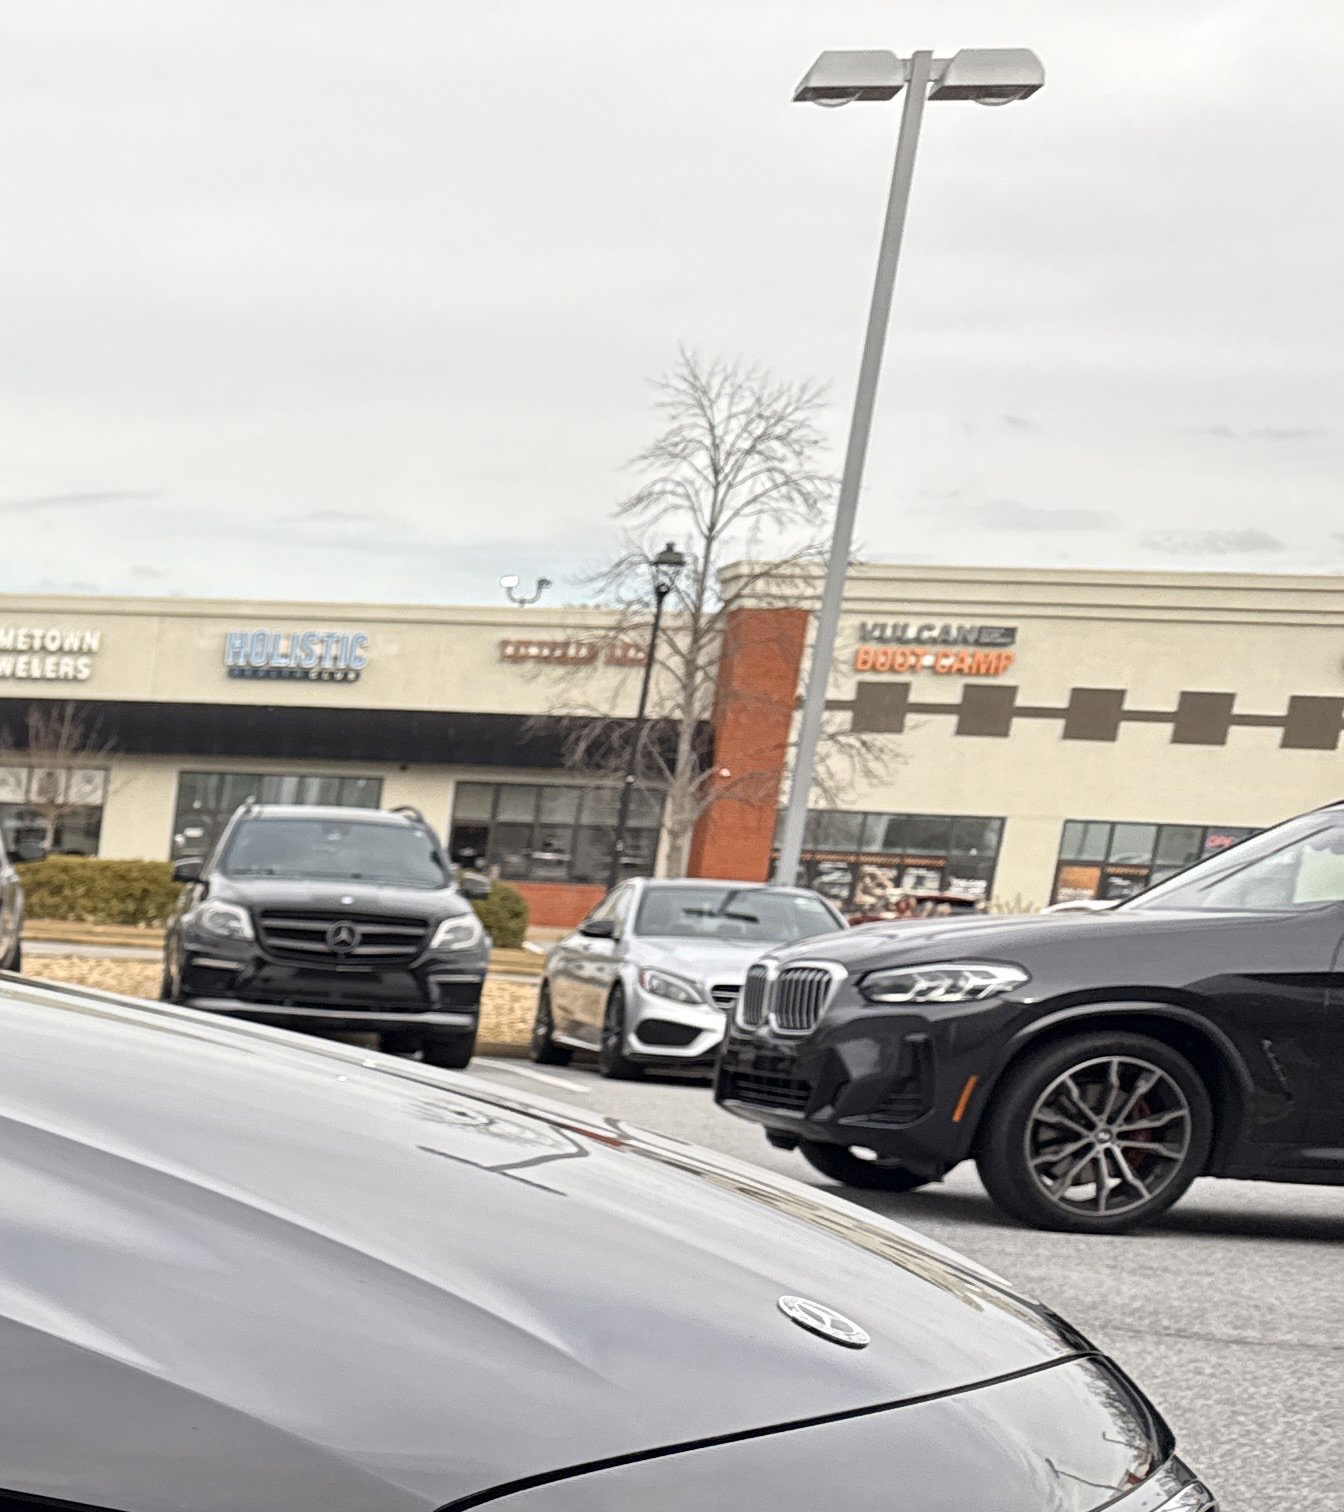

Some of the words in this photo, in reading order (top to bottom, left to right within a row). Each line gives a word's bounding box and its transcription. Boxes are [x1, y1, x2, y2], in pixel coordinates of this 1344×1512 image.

[225, 629, 369, 669] HOLISTIC
[860, 622, 978, 646] VULCAN
[855, 646, 928, 673] BOOT
[934, 648, 1015, 677] CAMP
